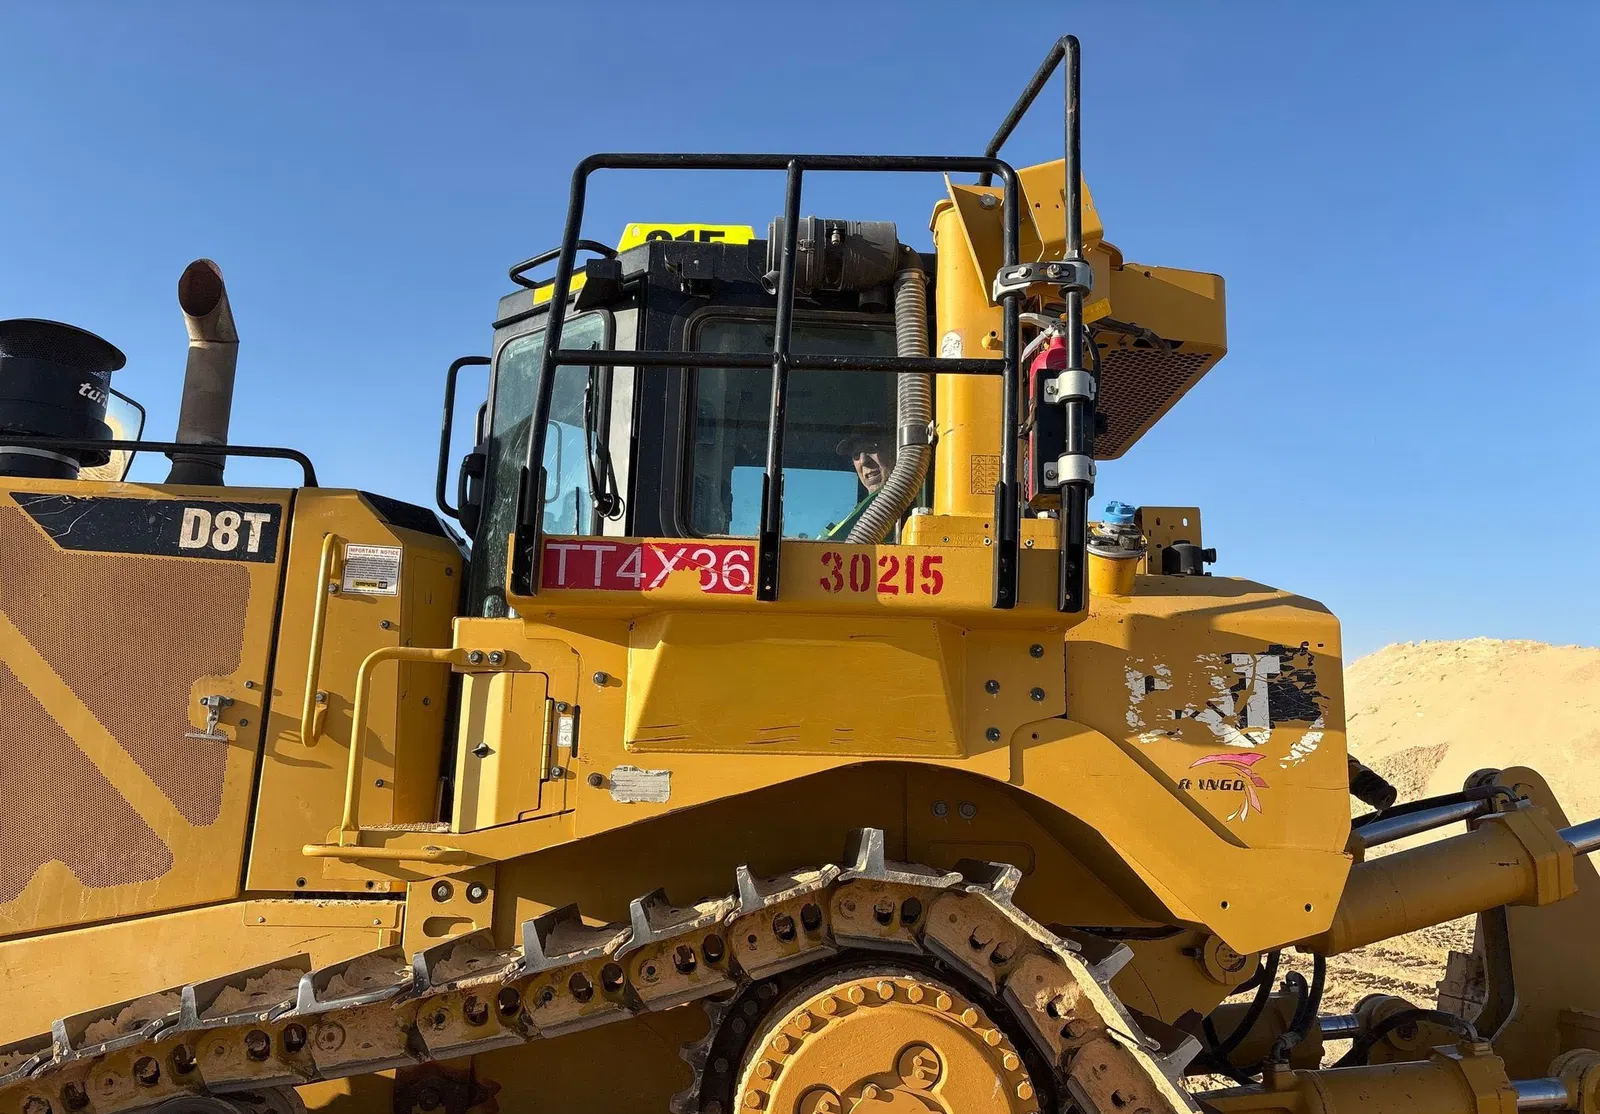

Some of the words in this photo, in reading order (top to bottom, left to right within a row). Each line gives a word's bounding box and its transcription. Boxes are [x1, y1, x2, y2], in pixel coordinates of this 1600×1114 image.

[179, 507, 271, 553] D8T
[546, 543, 750, 592] TT4X36
[820, 551, 943, 595] 30215
